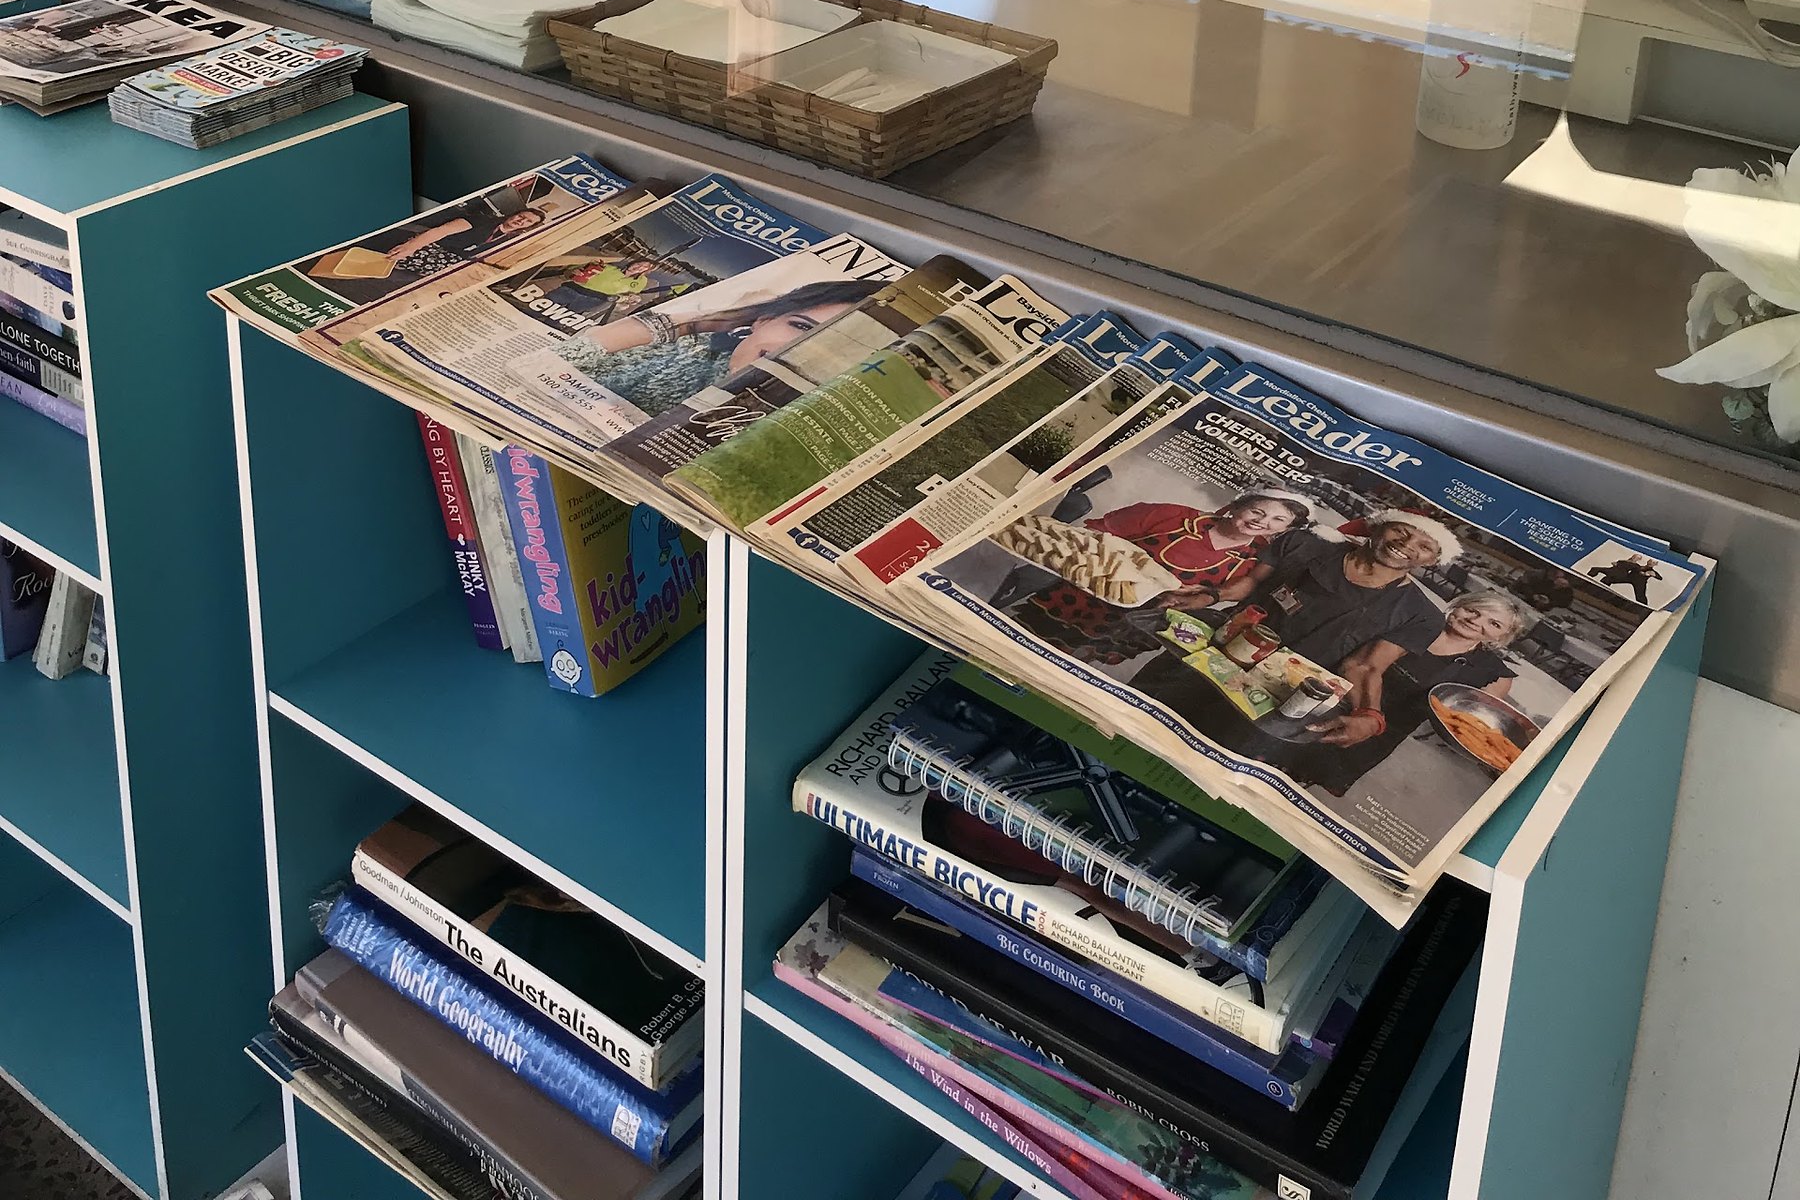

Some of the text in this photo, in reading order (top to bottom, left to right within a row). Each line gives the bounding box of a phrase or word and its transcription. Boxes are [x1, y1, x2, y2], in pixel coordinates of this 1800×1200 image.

[260, 42, 281, 52] THE
[266, 50, 315, 68] BIG
[190, 62, 258, 88] MARKET
[218, 52, 286, 79] DESIGN
[547, 155, 619, 200] Lea
[685, 179, 811, 252] Leade
[722, 188, 754, 212] Mordialloc
[752, 208, 776, 223] Chelsea
[242, 289, 279, 316] THRIFT PARK
[255, 282, 316, 319] FRESH
[510, 283, 598, 331] Bewar
[1016, 297, 1061, 330] Bayside
[982, 316, 1004, 335] OCTOBER
[0, 322, 81, 374] LONE TOGETH
[0, 345, 36, 374] en-faith
[475, 384, 500, 402] facebook
[536, 373, 594, 411] 1300 365 555
[559, 372, 608, 402] DAMART
[836, 373, 876, 400] PAVILION
[875, 398, 908, 428] PALAVE
[1263, 379, 1338, 425] Mordialloc Chelsea
[811, 390, 880, 444] ROSSINGS TO BE
[856, 400, 875, 419] PAGE
[1214, 390, 1269, 421] Wednesday, December
[1220, 370, 1423, 472] Leader
[659, 431, 688, 453] Christmas
[664, 427, 692, 448] presents
[689, 432, 708, 446] begin
[803, 415, 834, 445] ESTATE
[839, 428, 859, 446] PAGE
[1205, 412, 1306, 467] CHEERS TO
[479, 445, 496, 475] CLASSICS
[644, 438, 673, 459] message
[810, 445, 831, 465] PAGE
[1164, 441, 1234, 480] cheer among those
[1174, 434, 1231, 464] army people
[1181, 430, 1265, 477] Today we celebrate the
[1188, 445, 1242, 477] spread festive
[1193, 420, 1315, 484] VOLUNTEERS
[1147, 452, 1200, 482] REPORT PAGE
[1152, 448, 1226, 490] meet this Christmas.
[1158, 444, 1245, 494] struggling make ends
[431, 445, 464, 526] BY HEART
[567, 496, 583, 508] The
[1443, 487, 1483, 511] DILEMMA
[1446, 495, 1467, 509] PAGE
[1451, 478, 1496, 503] COUNCILS'
[1453, 486, 1484, 504] WEEDY
[506, 444, 563, 615] idwrangling
[569, 504, 594, 522] caring
[580, 508, 612, 530] toddlers
[583, 510, 628, 547] preschoolers
[1519, 518, 1571, 549] THE SOUND
[1527, 529, 1567, 550] RESPECT
[1528, 516, 1584, 546] DANCING TO
[1529, 535, 1549, 549] PAGE
[454, 550, 476, 598] McKAY
[465, 551, 486, 593] PINKY
[585, 551, 645, 629] kid-
[590, 550, 707, 670] wranglin
[825, 652, 959, 776] RICHARD BALLAN
[951, 589, 1368, 852] Like the Mordialloc Chelsea Leader page Facebook for news updates, photos community issues and more
[849, 754, 882, 785] AND
[813, 796, 1038, 930] ULTIMATE BICYCLE
[873, 872, 899, 890] FROZEN
[1050, 930, 1144, 983] AND RICHARD GRANT
[1051, 919, 1146, 974] RICHARD BALLANTINE
[359, 860, 633, 1069] Goodman Johnston The Australians
[996, 933, 1125, 1012] BIG COLOURING BOOK
[389, 948, 438, 1007] World
[436, 982, 529, 1074] Geography
[640, 1002, 675, 1035] Robert
[650, 1007, 687, 1042] George
[639, 1050, 647, 1082] RIGBY
[977, 1011, 1006, 1032] AT
[1008, 1027, 1068, 1069] WAR
[1106, 1087, 1155, 1121] ROBIN
[1158, 1117, 1210, 1153] CROSS
[1315, 1108, 1348, 1152] WORLD
[1343, 1078, 1361, 1110] WAR
[1358, 1049, 1379, 1081] AND
[1371, 1010, 1399, 1053] WORLD
[1392, 989, 1411, 1020] WAR
[906, 1052, 1052, 1175] The Wind in the Willows
